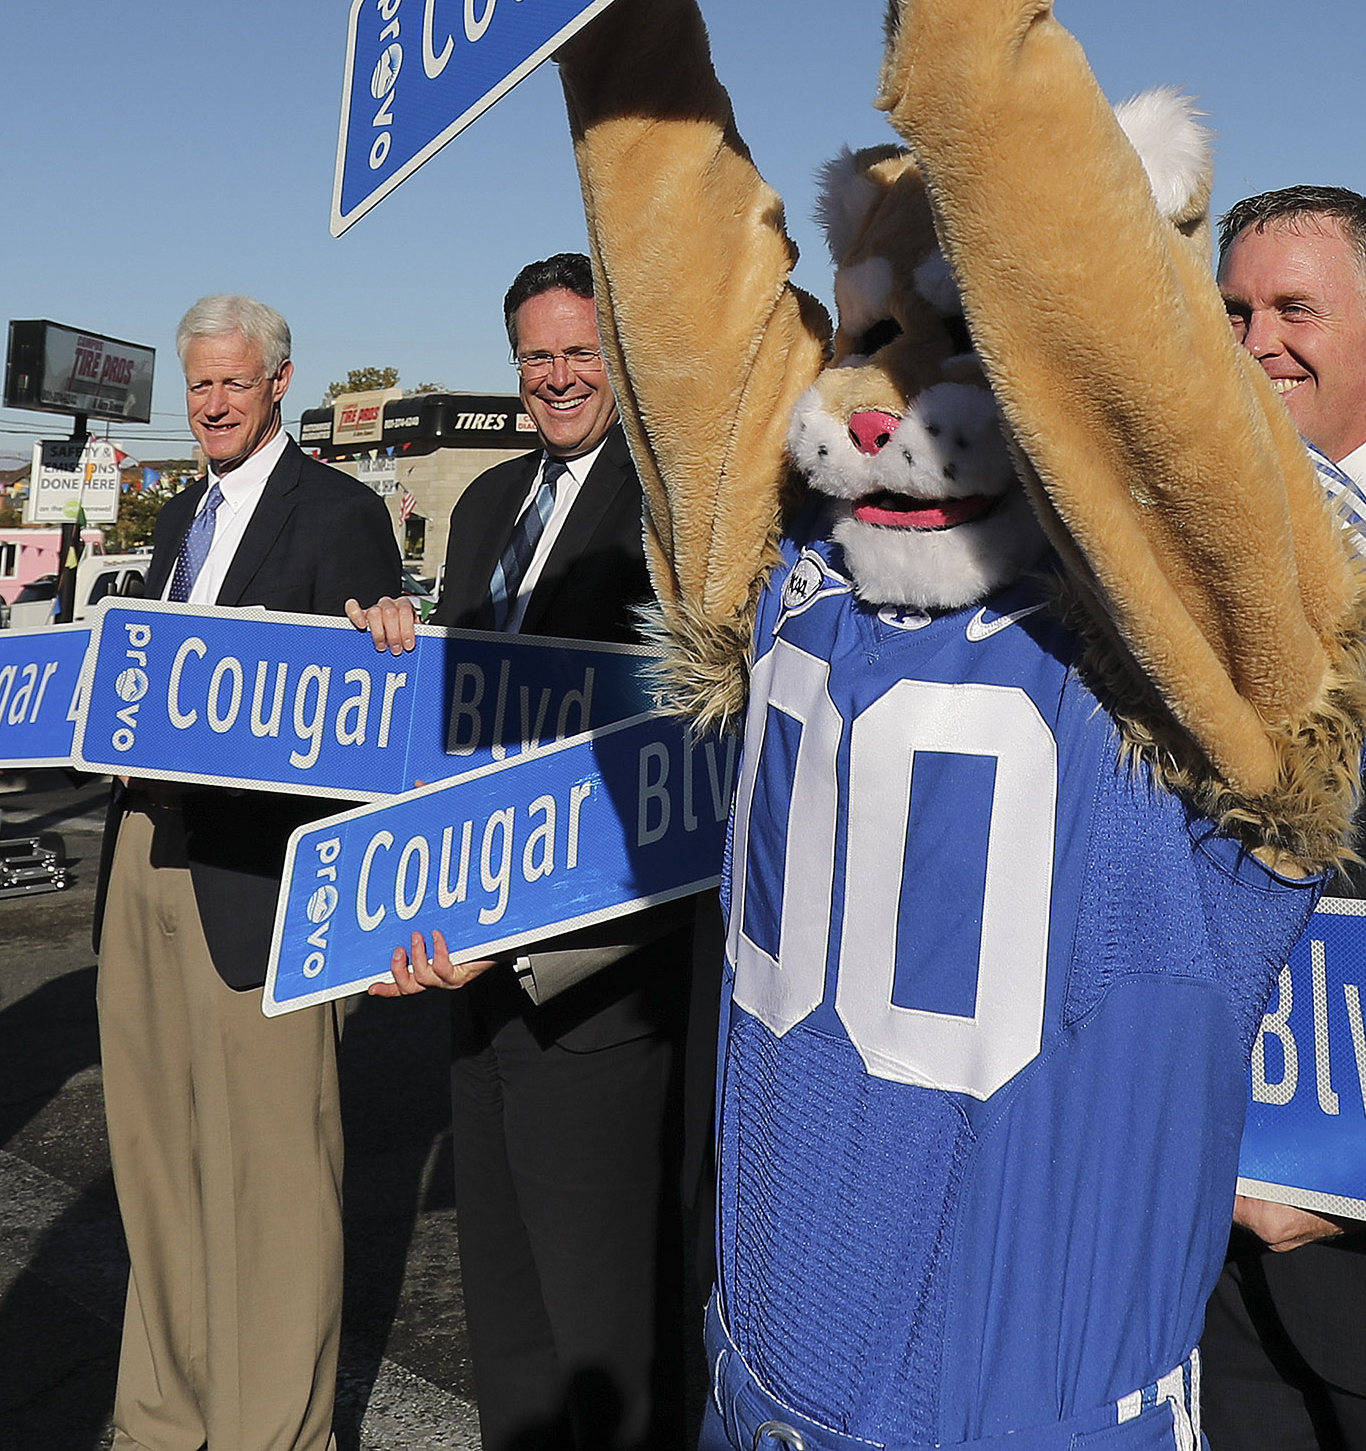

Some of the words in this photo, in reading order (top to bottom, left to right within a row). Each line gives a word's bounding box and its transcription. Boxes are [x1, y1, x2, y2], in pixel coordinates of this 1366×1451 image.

[67, 348, 103, 390] TIRE
[454, 412, 508, 431] TIRES
[41, 478, 80, 490] DONE
[83, 478, 116, 491] HERE
[166, 637, 408, 770] Cougar
[445, 659, 596, 761] Blvd
[355, 779, 594, 932] Cougar
[637, 724, 738, 847] Blv
